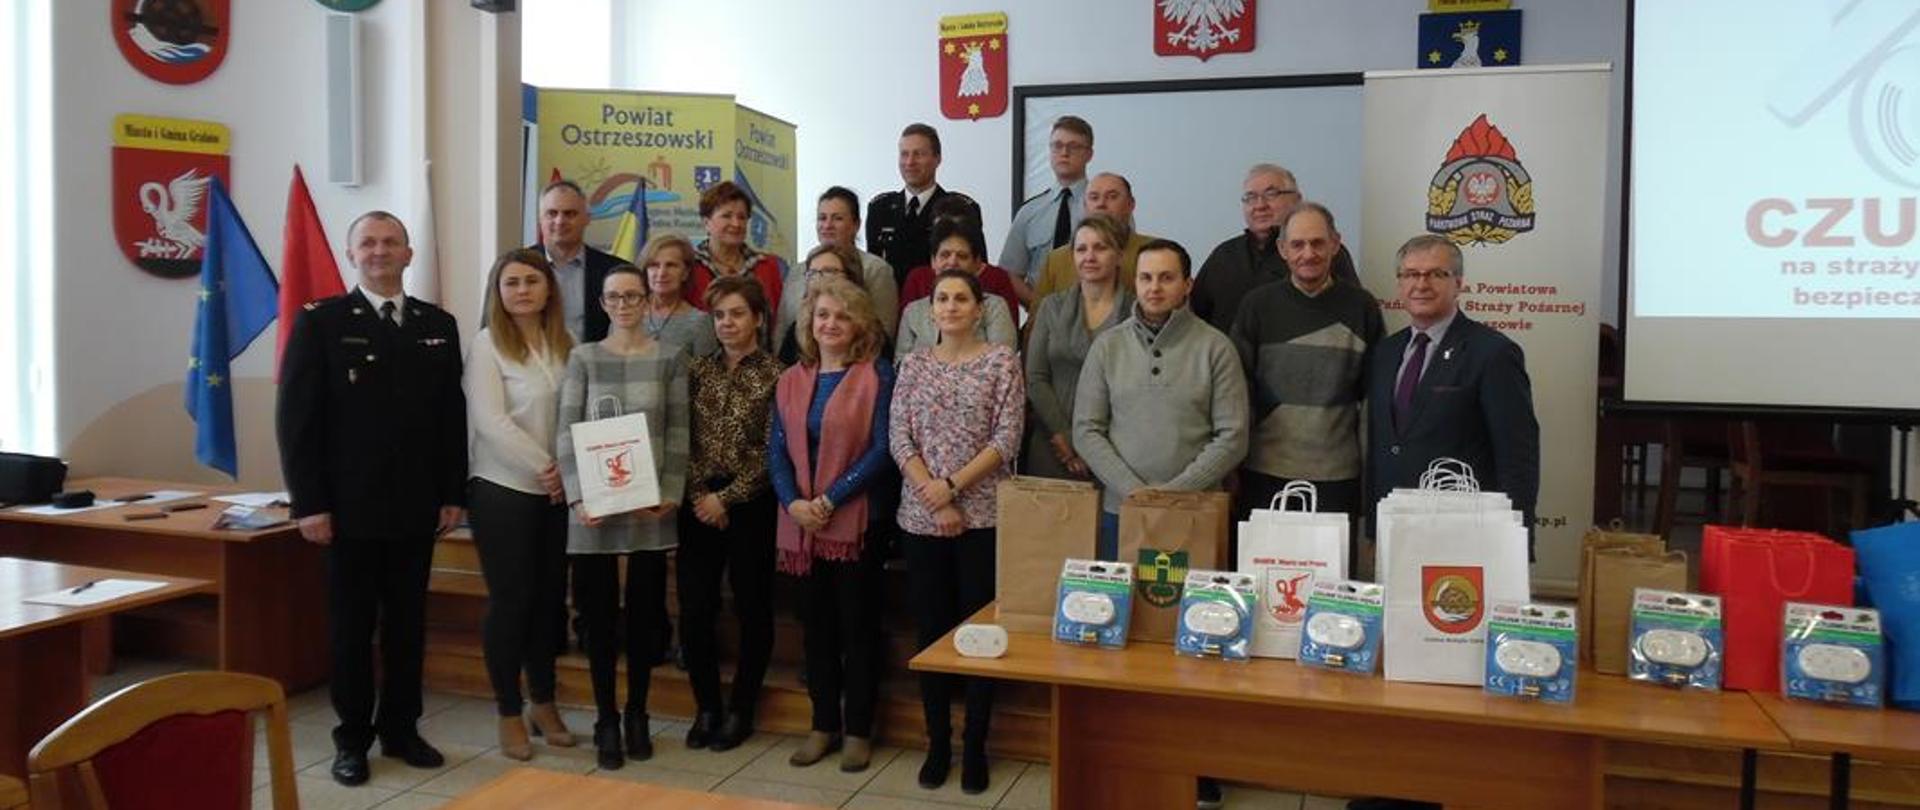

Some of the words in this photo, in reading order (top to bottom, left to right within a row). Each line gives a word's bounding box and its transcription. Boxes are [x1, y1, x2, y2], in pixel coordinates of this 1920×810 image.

[602, 103, 674, 127] Powiat
[561, 123, 714, 150] Ostrzeszowski
[1745, 197, 1918, 249] CZU
[1780, 260, 1816, 275] na
[1827, 255, 1920, 279] straży
[1476, 283, 1557, 295] Powiatowa
[1465, 300, 1513, 314] Straży
[1518, 300, 1586, 317] Pożarnej
